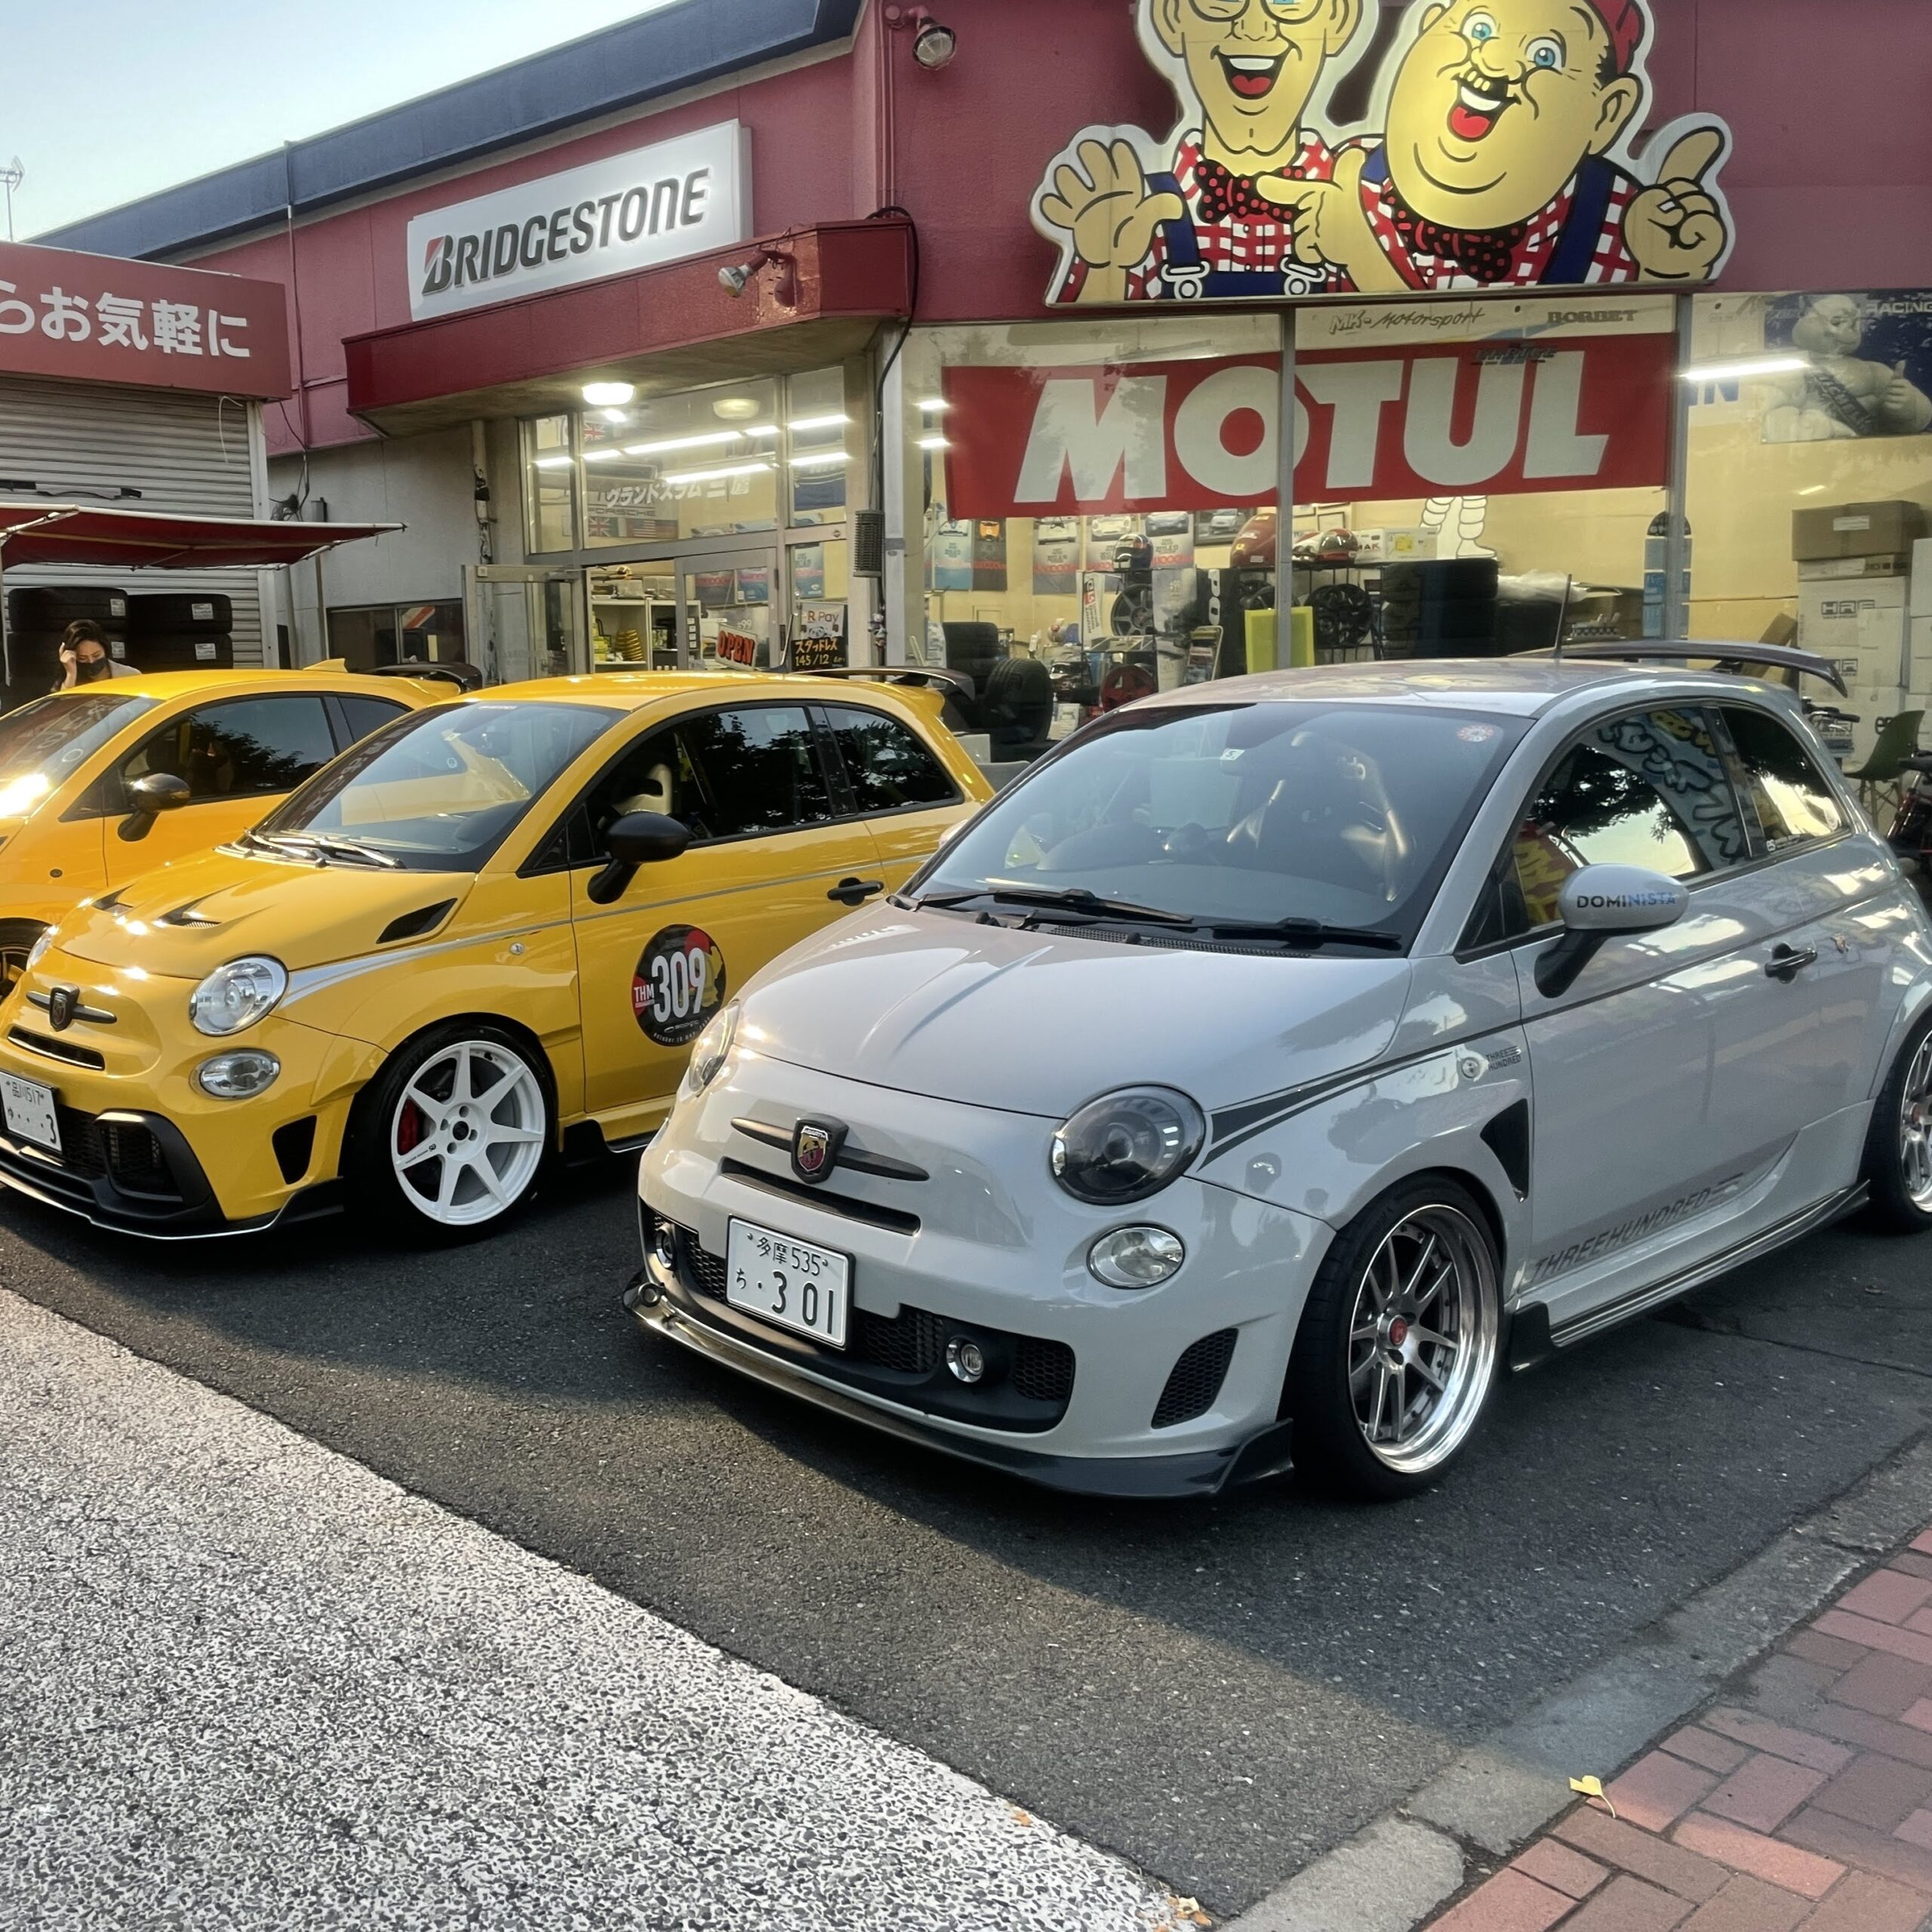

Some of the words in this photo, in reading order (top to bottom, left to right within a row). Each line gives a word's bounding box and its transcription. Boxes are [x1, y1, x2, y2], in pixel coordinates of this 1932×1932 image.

[421, 167, 709, 295] BRIDGESTONE
[1014, 350, 1609, 502] MOTUL
[818, 611, 838, 623] Pay
[718, 629, 755, 666] OPEN
[1577, 891, 1676, 908] DOMINISTA
[634, 983, 654, 1003] THM
[651, 947, 706, 1023] 309
[1488, 1055, 1521, 1071] HUNDRED
[737, 1268, 746, 1289] ち
